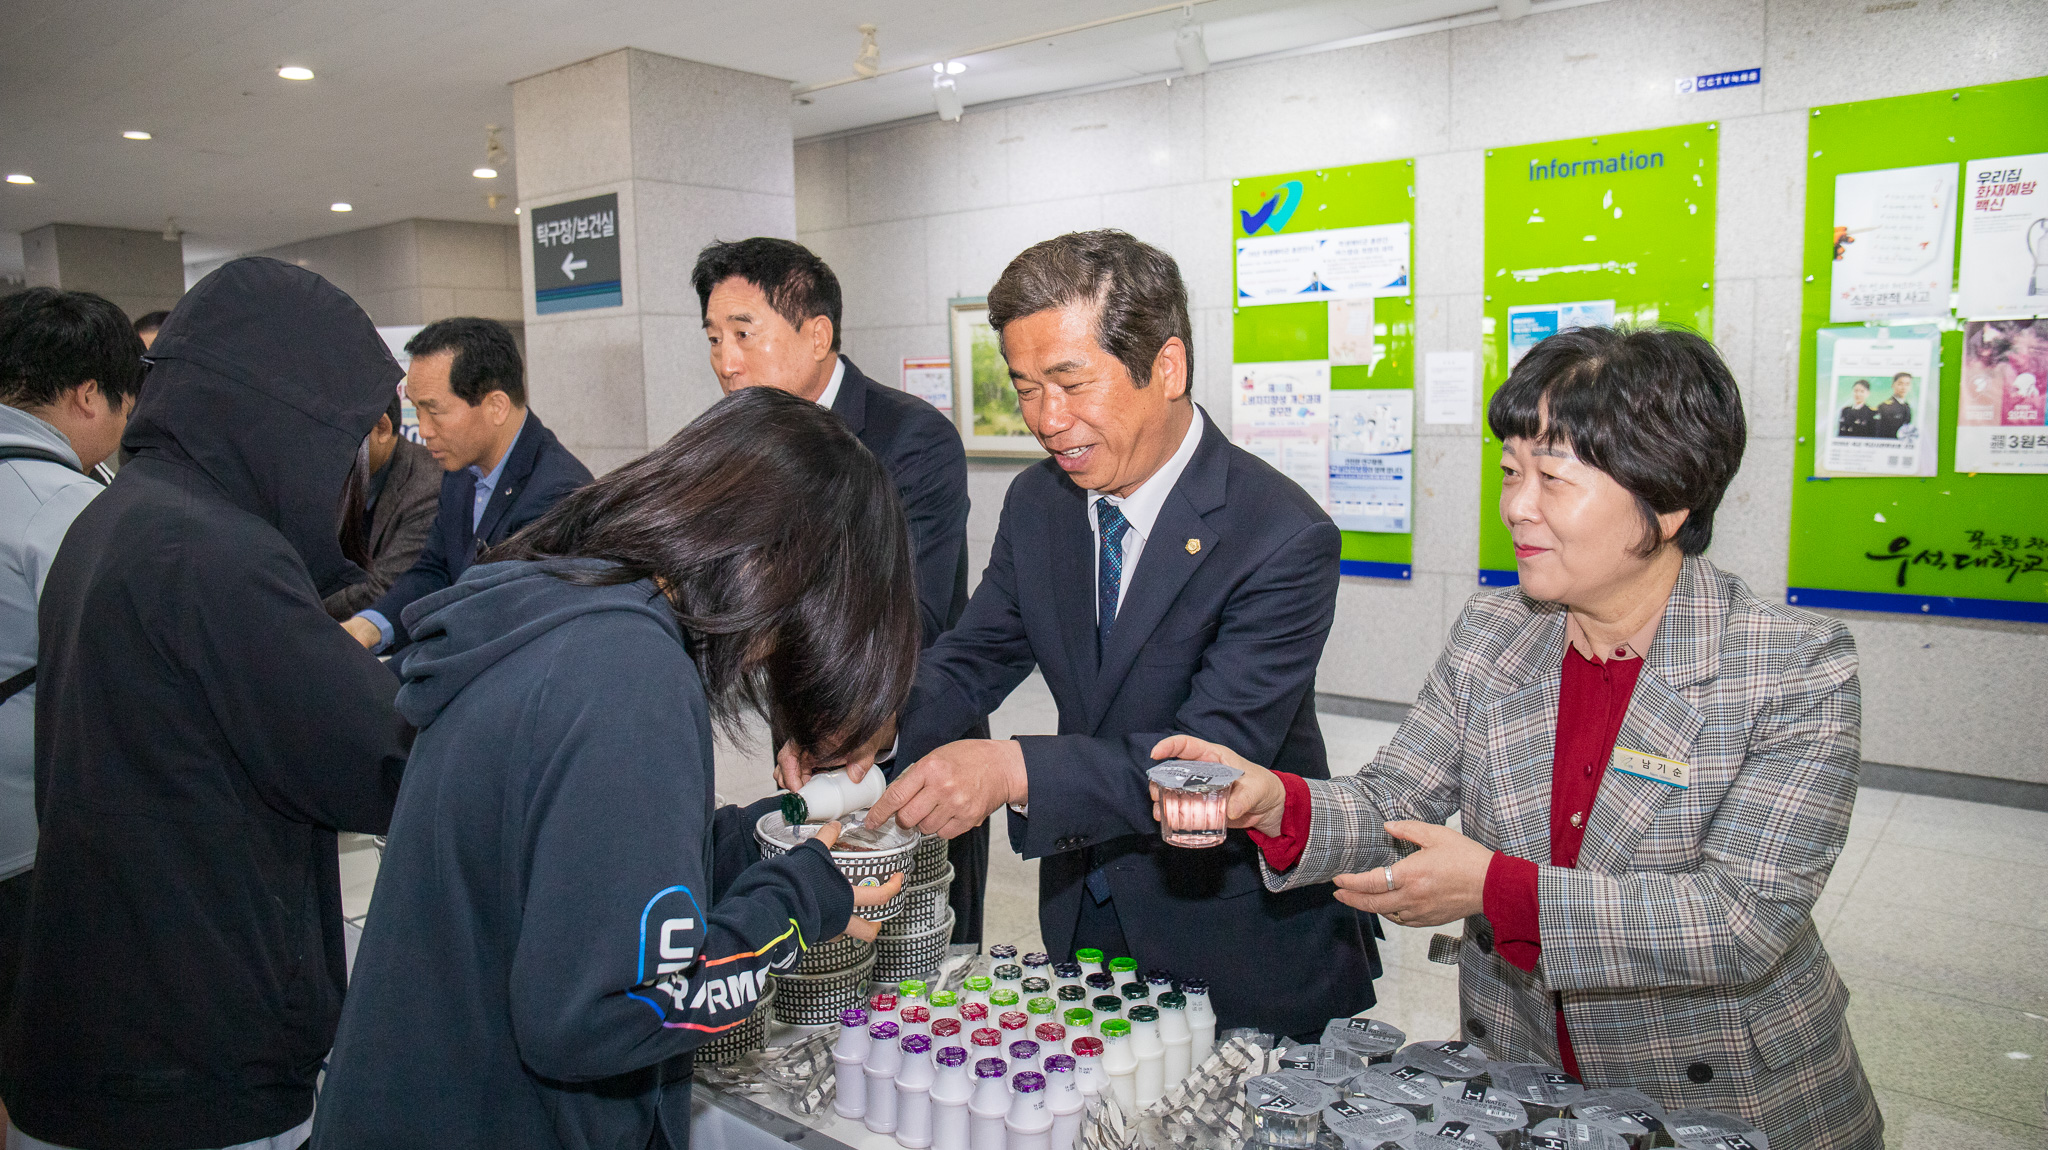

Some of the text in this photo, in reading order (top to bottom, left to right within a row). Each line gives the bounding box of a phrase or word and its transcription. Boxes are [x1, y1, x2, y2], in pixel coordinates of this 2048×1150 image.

[1529, 150, 1664, 181] Information
[1976, 168, 2022, 186] 우리집
[1975, 181, 2037, 199] 화재예방
[1975, 197, 2005, 212] 백신
[536, 210, 614, 248] 탁구장/보건실
[1850, 290, 1930, 306] 소방관적 사고
[1485, 1099, 1508, 1108] WATER
